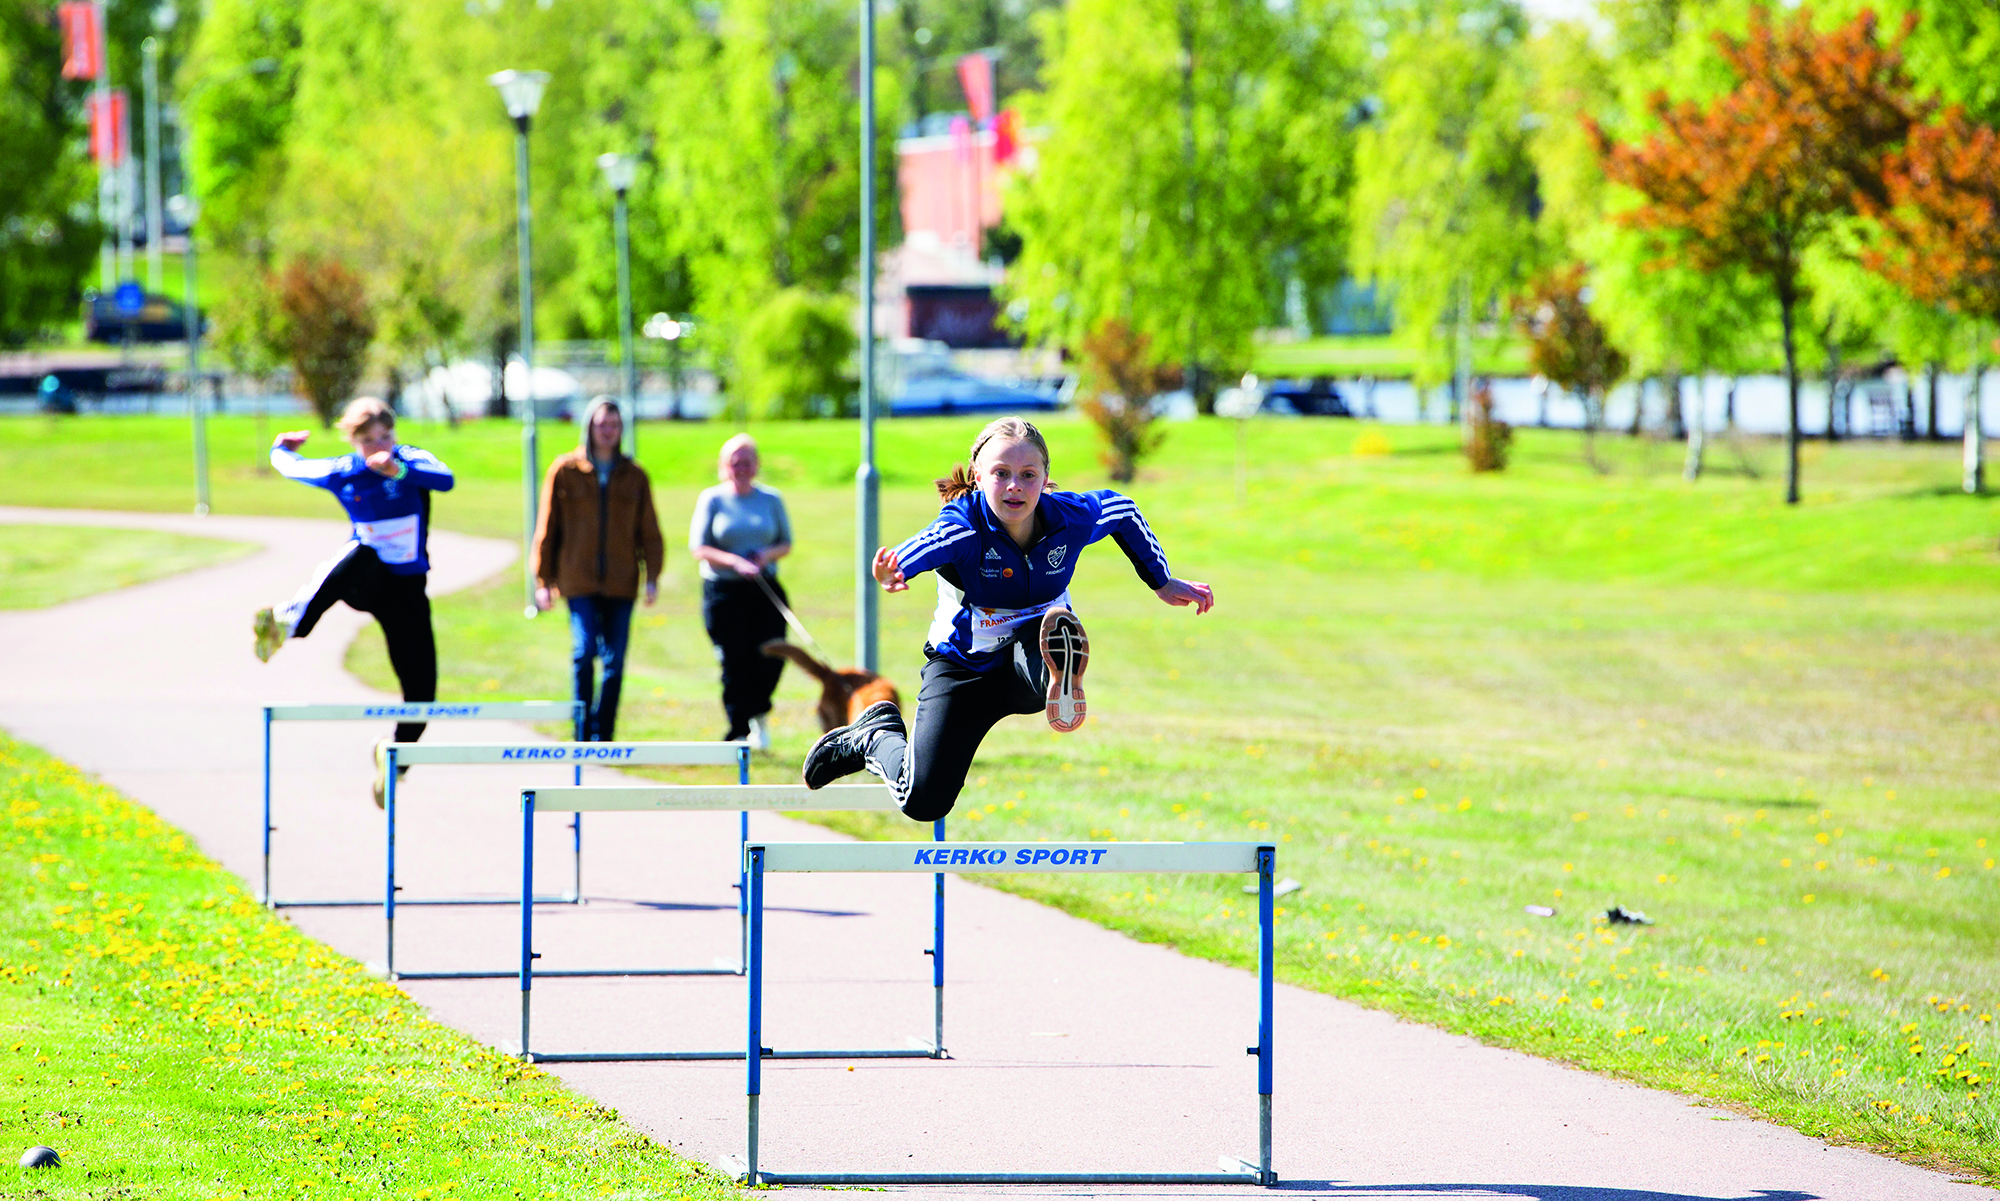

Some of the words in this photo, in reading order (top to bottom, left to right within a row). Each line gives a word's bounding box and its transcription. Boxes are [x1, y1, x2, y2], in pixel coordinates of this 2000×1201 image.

[502, 747, 566, 759] KERKO
[573, 747, 635, 759] SPORT
[914, 849, 1007, 865] KERKO
[1014, 849, 1107, 865] SPORT
